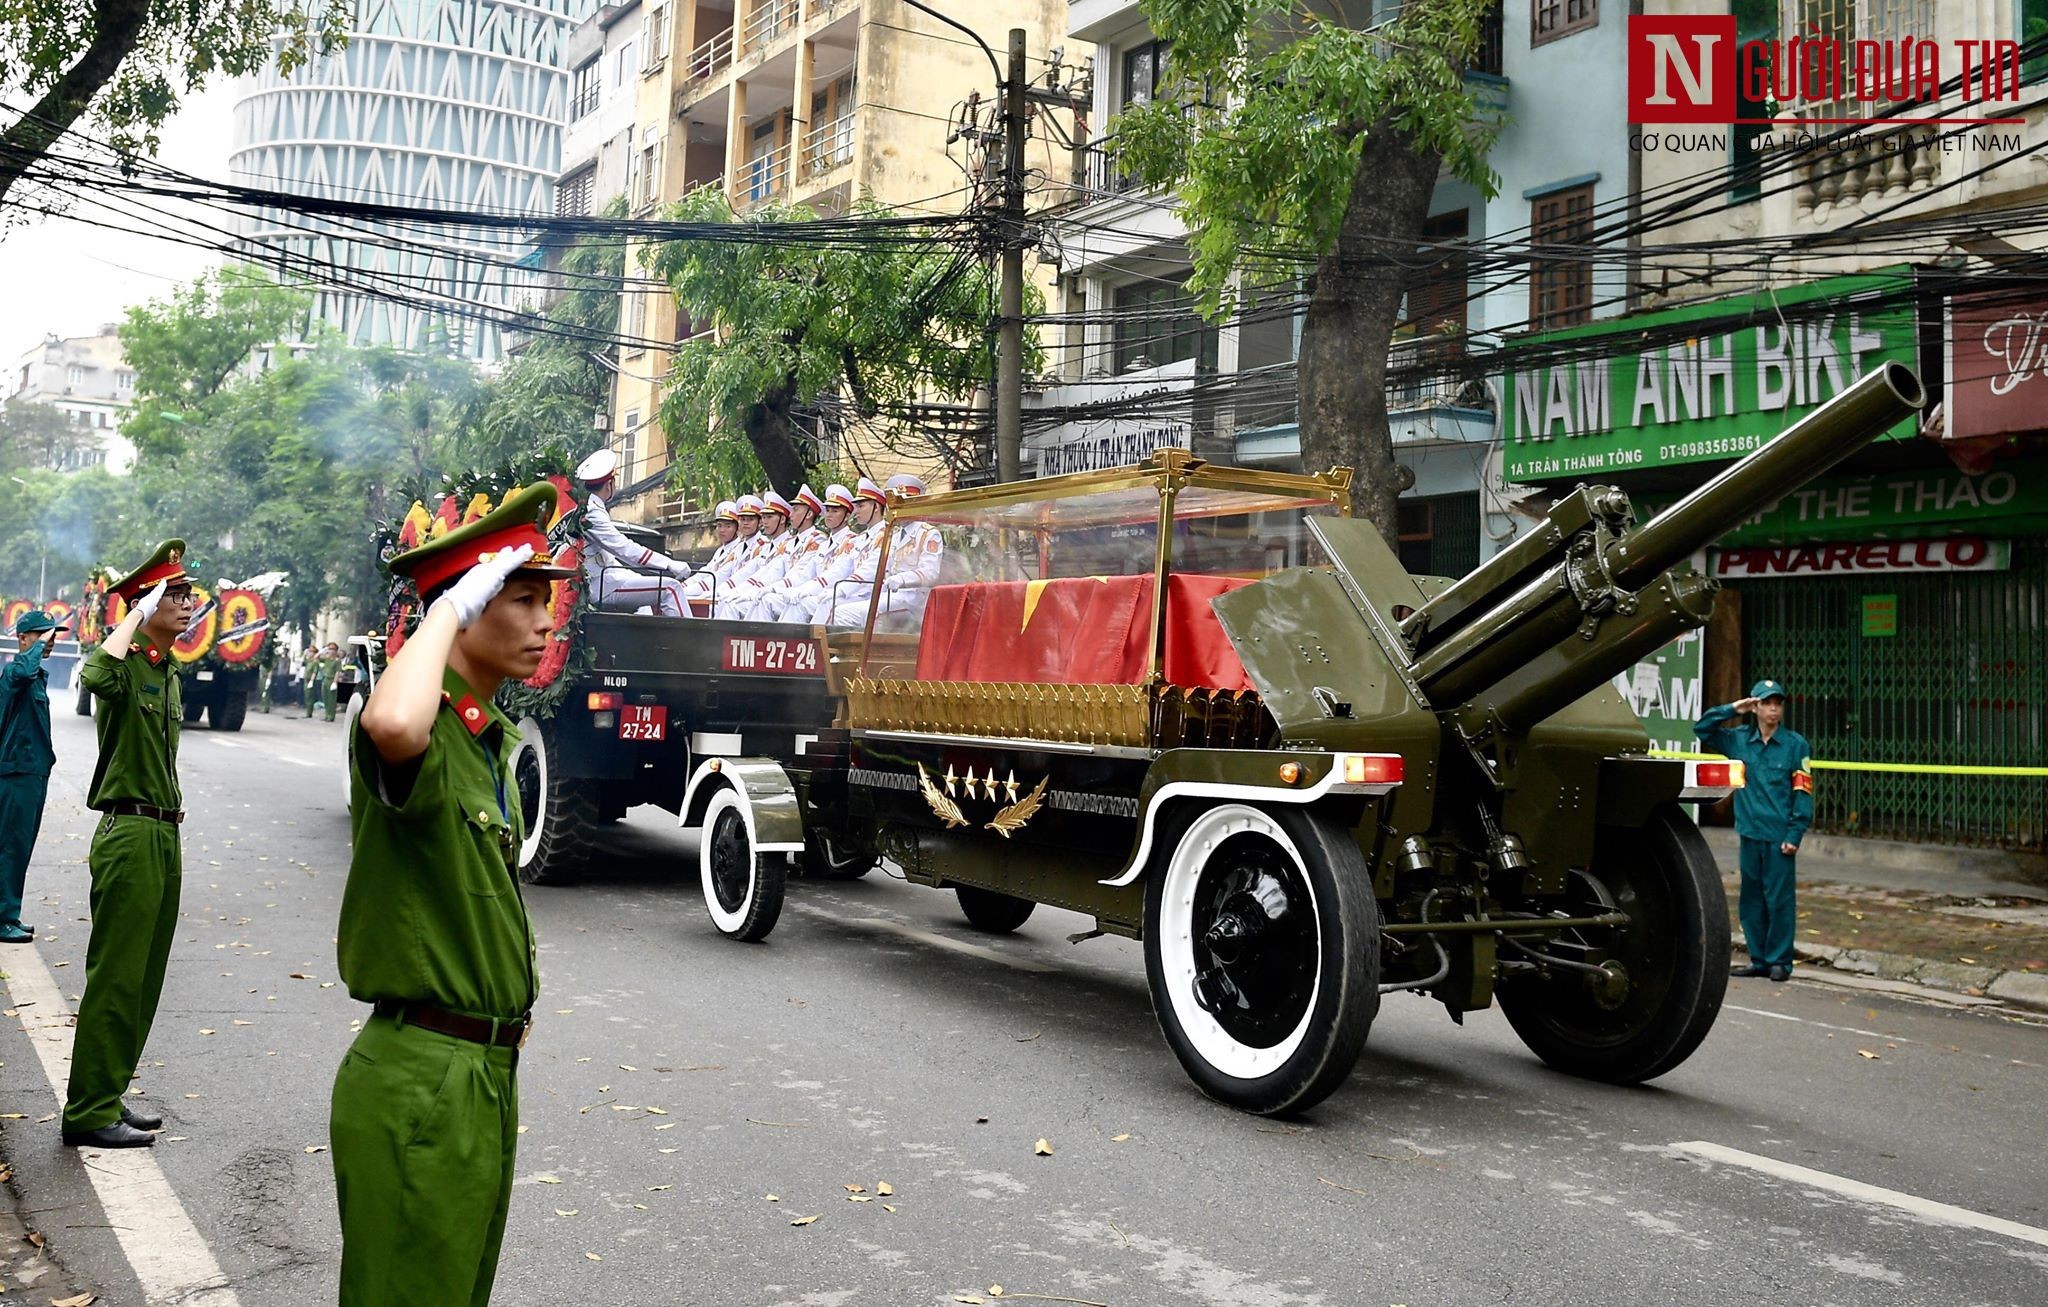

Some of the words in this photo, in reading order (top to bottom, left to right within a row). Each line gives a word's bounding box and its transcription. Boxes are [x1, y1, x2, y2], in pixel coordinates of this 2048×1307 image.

[1515, 352, 1609, 443] NAM
[1510, 463, 1524, 476] 1A
[1718, 538, 1987, 574] PINARELLO
[730, 639, 816, 670] TM-27-24
[635, 706, 652, 721] TM
[623, 723, 661, 739] 27-24
